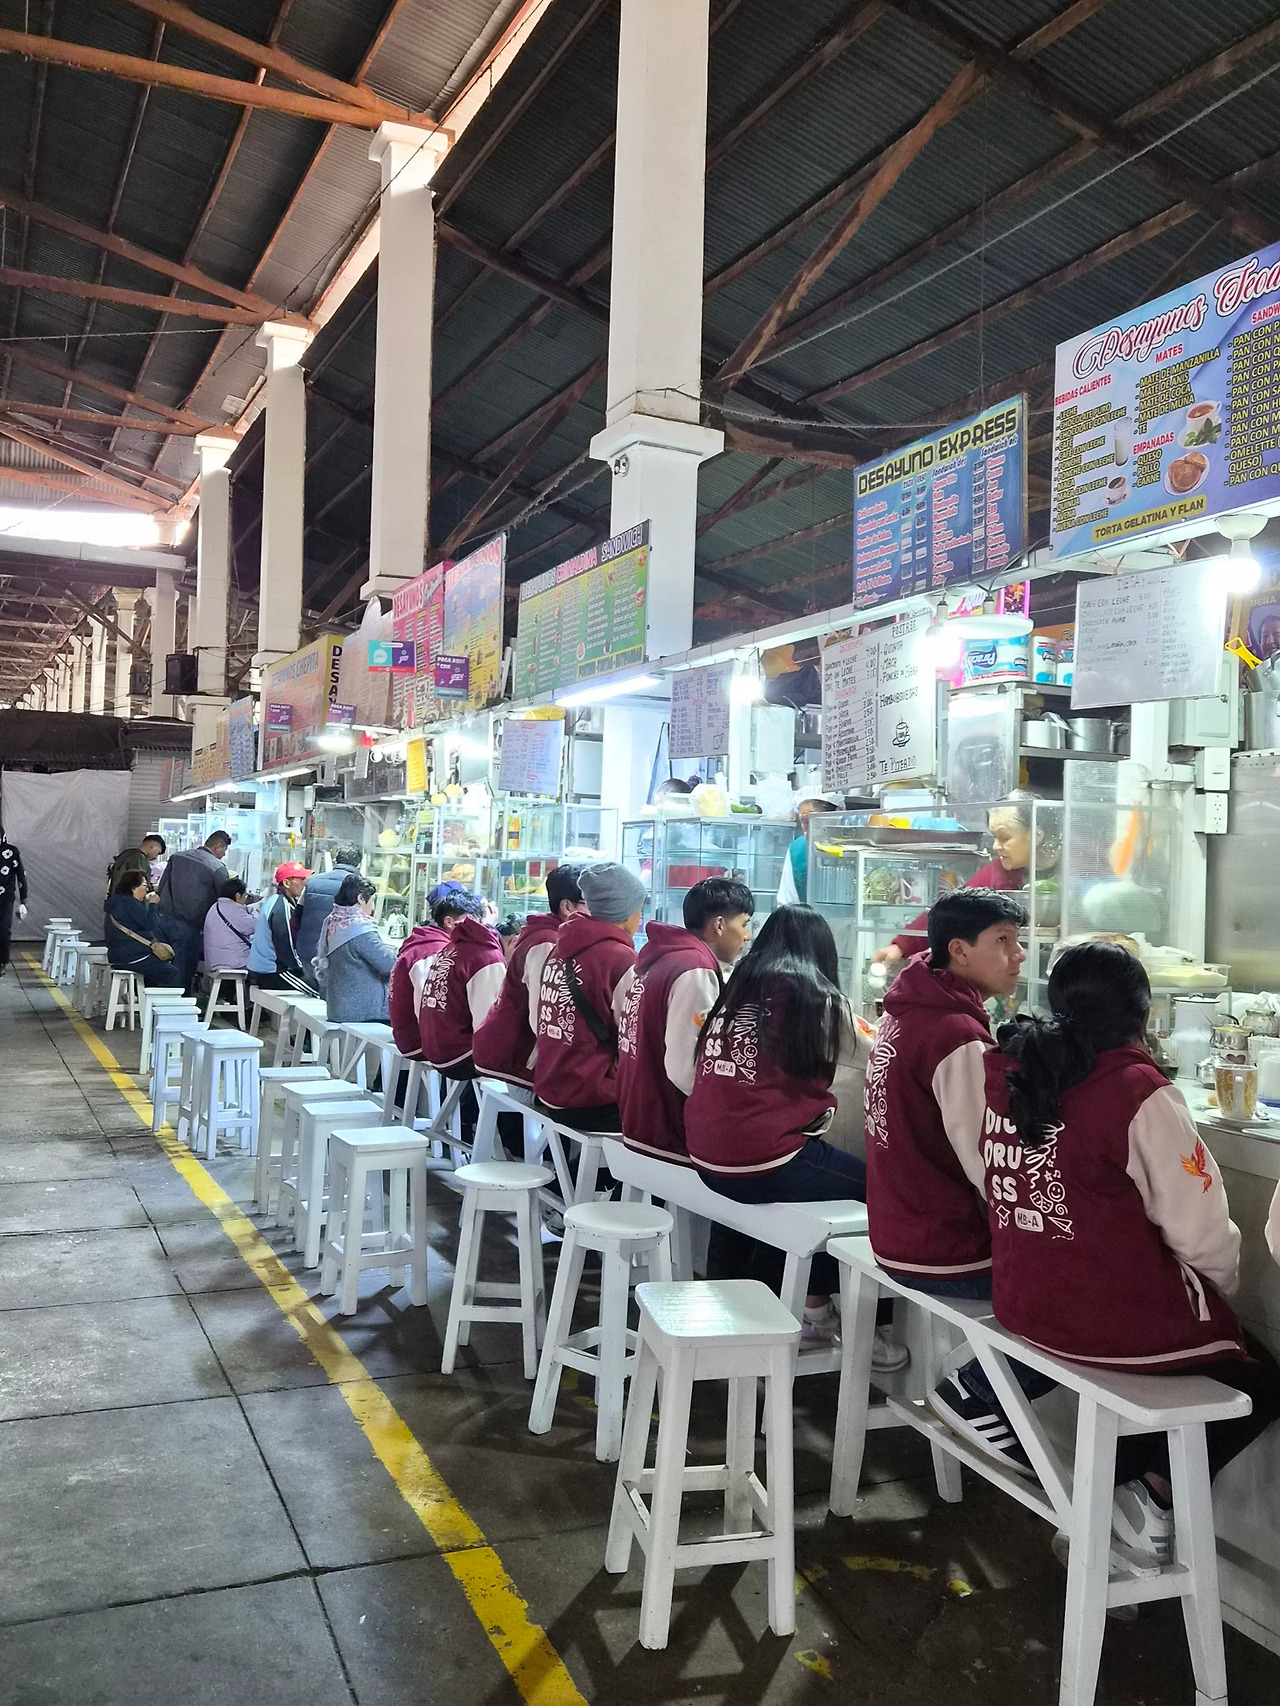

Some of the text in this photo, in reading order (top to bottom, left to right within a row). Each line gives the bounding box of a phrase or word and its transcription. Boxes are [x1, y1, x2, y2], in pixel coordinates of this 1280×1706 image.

[1073, 295, 1208, 379] Desayunos
[1233, 322, 1272, 347] PAN CON
[1155, 344, 1183, 364] MATES
[1232, 337, 1272, 360] PAN CON
[1140, 347, 1220, 388] MATE DE MANZANILLA
[1232, 350, 1271, 372] PAN CON
[1232, 362, 1270, 385] PAN CON
[1055, 374, 1112, 406] BEBIDAS CALIENTES
[1140, 370, 1189, 400] MATE DE ANIS
[1232, 376, 1270, 398] PAN CON
[1139, 382, 1192, 412] MATE DE COCA
[1232, 388, 1270, 410] PAN CON
[1060, 405, 1078, 420] LECHE
[1060, 409, 1093, 430] CHOCOLATE
[1060, 420, 1092, 440] CHOCOLATE
[1108, 406, 1127, 422] LECHE
[1139, 402, 1170, 423] MATE DE
[1232, 402, 1270, 423] PAN CON
[1138, 422, 1147, 434] TE
[1231, 414, 1270, 436] PAN CON
[981, 436, 1008, 458] Sandwich
[1133, 432, 1175, 455] EMPANADAS
[1231, 428, 1269, 448] PAN CON
[858, 408, 1017, 496] DESAYUNO EXPRESS
[1138, 448, 1162, 466] QUESO
[1230, 438, 1276, 461] OMELETTE
[1137, 460, 1160, 476] POLLO
[1229, 454, 1262, 474] QUESO)
[1137, 471, 1160, 488] CARNE
[1229, 466, 1268, 486] PAN CON
[1095, 498, 1204, 538] TORTA GELATINA Y FLAN
[601, 524, 643, 562] SANDWICH
[705, 1038, 722, 1056] SS
[992, 1174, 1018, 1202] SS
